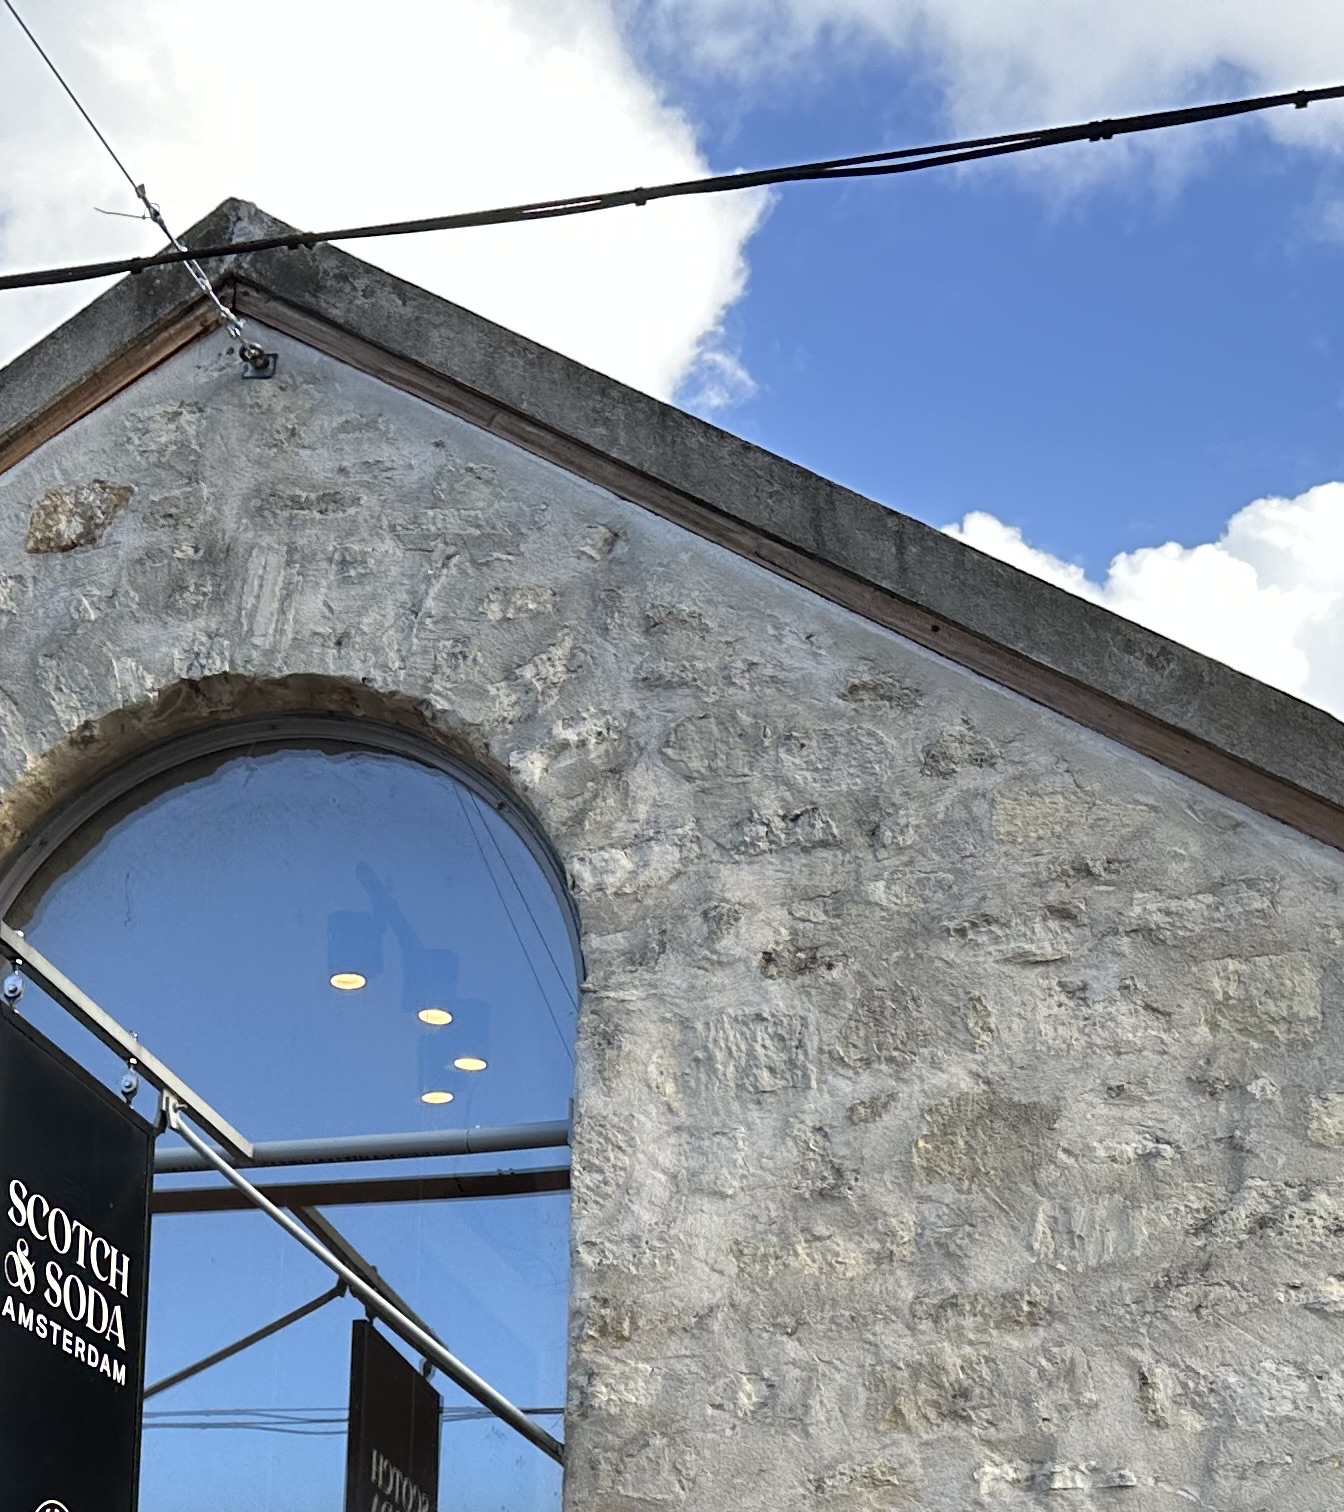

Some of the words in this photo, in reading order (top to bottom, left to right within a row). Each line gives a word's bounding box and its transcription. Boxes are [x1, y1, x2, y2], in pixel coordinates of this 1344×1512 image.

[4, 1237, 35, 1295] &
[44, 1260, 127, 1351] SODA
[7, 1179, 131, 1298] SCOTCH
[1, 1295, 126, 1386] AMSTERDAM
